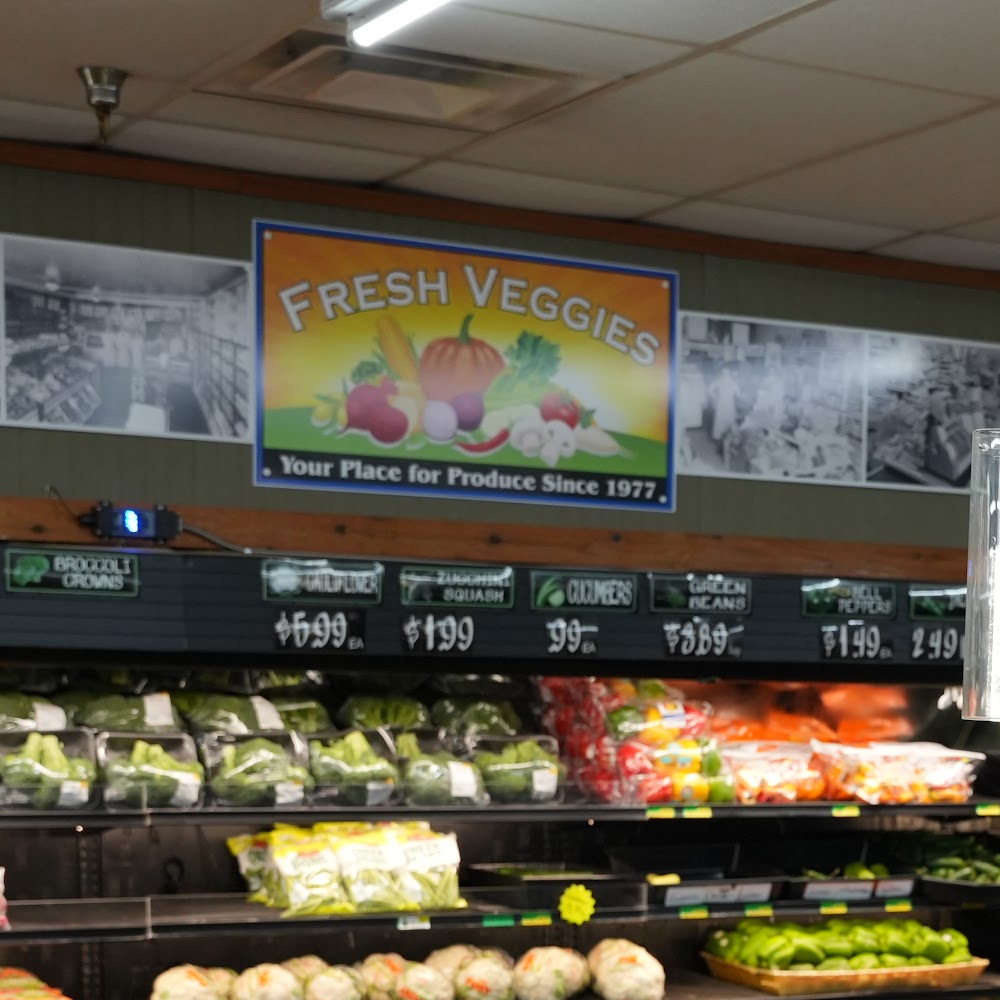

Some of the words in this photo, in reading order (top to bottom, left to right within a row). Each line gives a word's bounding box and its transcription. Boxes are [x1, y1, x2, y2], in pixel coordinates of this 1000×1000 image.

[278, 270, 449, 333] FRESH
[463, 264, 661, 367] VEGGIES
[280, 456, 332, 478] Your
[340, 459, 401, 482] Place
[408, 464, 440, 484] for
[447, 467, 537, 492] Produce
[541, 475, 600, 496] Since
[54, 555, 131, 575] BROCCOLI
[61, 573, 125, 590] CROWNS
[688, 578, 747, 594] GREEN
[443, 587, 504, 603] SQUASH
[566, 577, 633, 607] CUCUMBERS
[688, 595, 747, 611] BEANS
